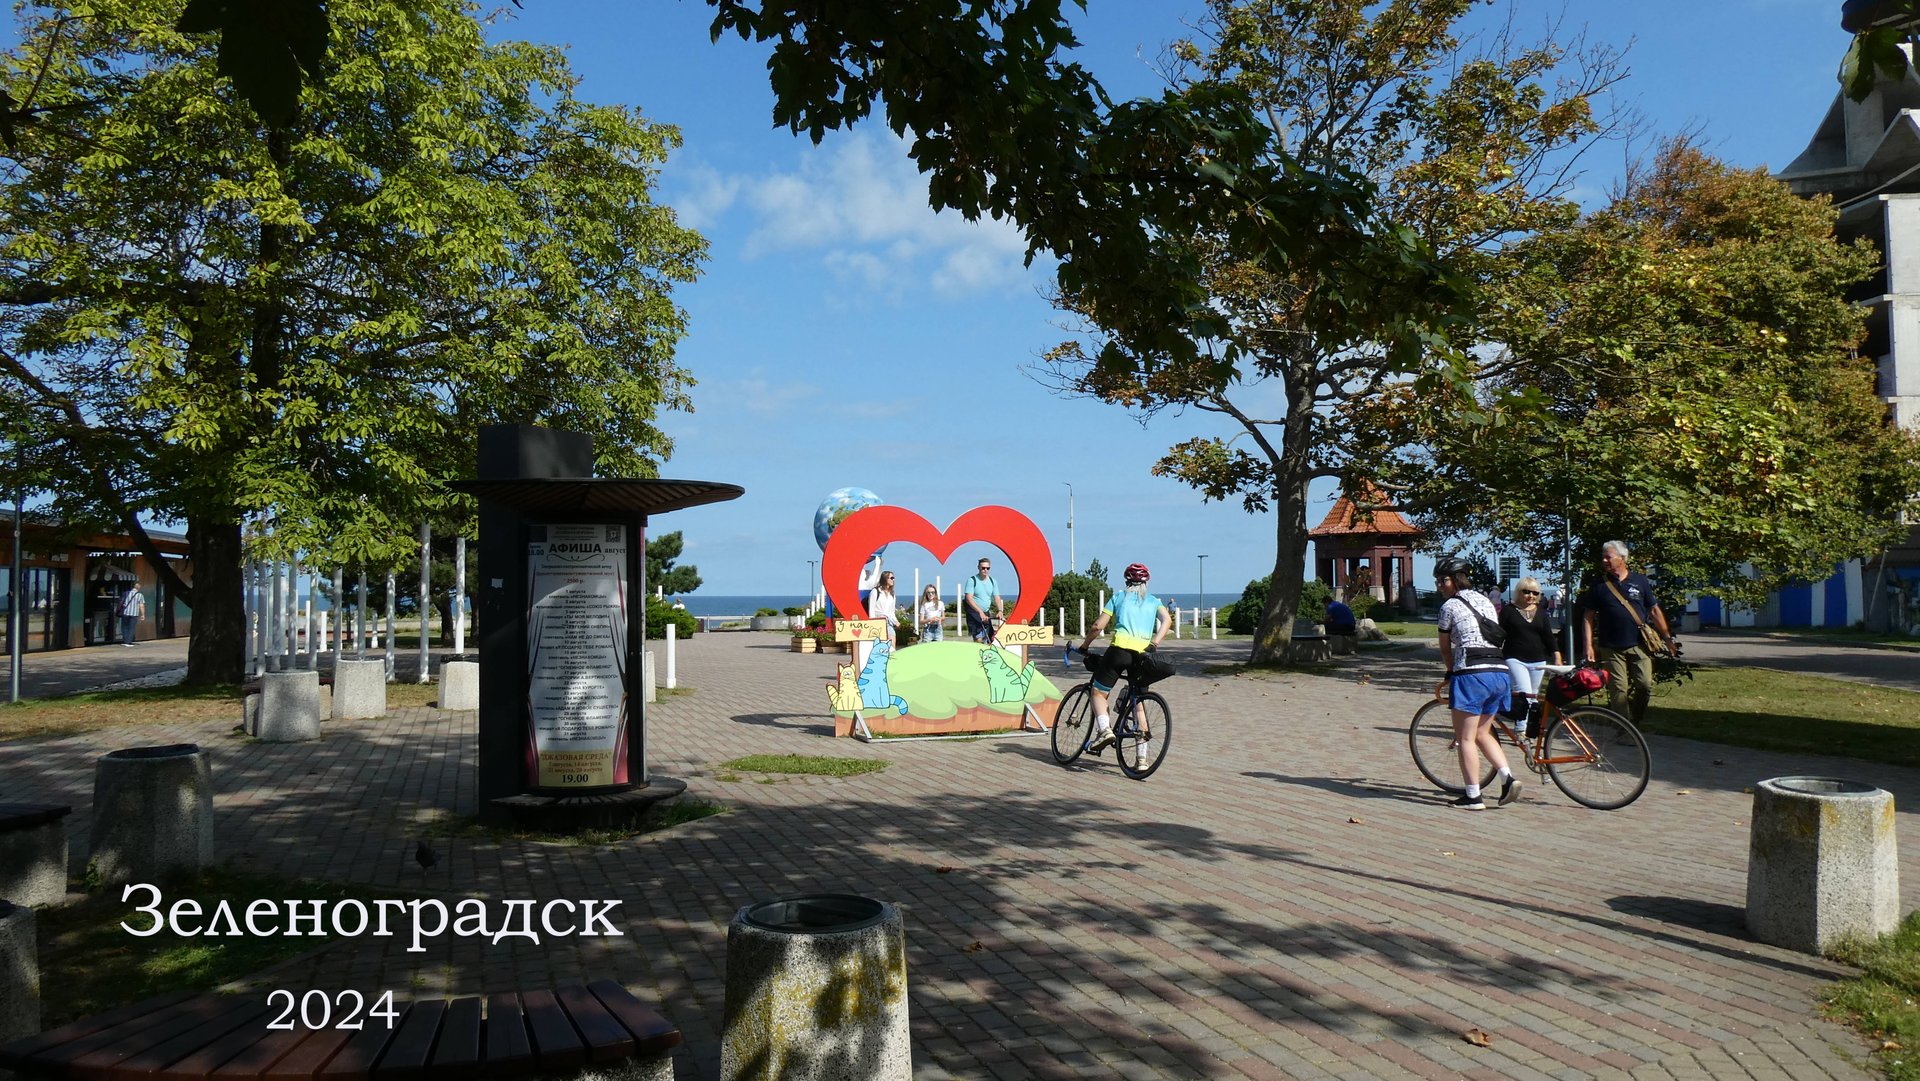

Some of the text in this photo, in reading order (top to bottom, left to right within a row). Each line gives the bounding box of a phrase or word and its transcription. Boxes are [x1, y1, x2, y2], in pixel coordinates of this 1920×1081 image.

[549, 544, 602, 553] АФИША
[1006, 628, 1046, 642] МОРЕ
[562, 774, 588, 782] 19.00
